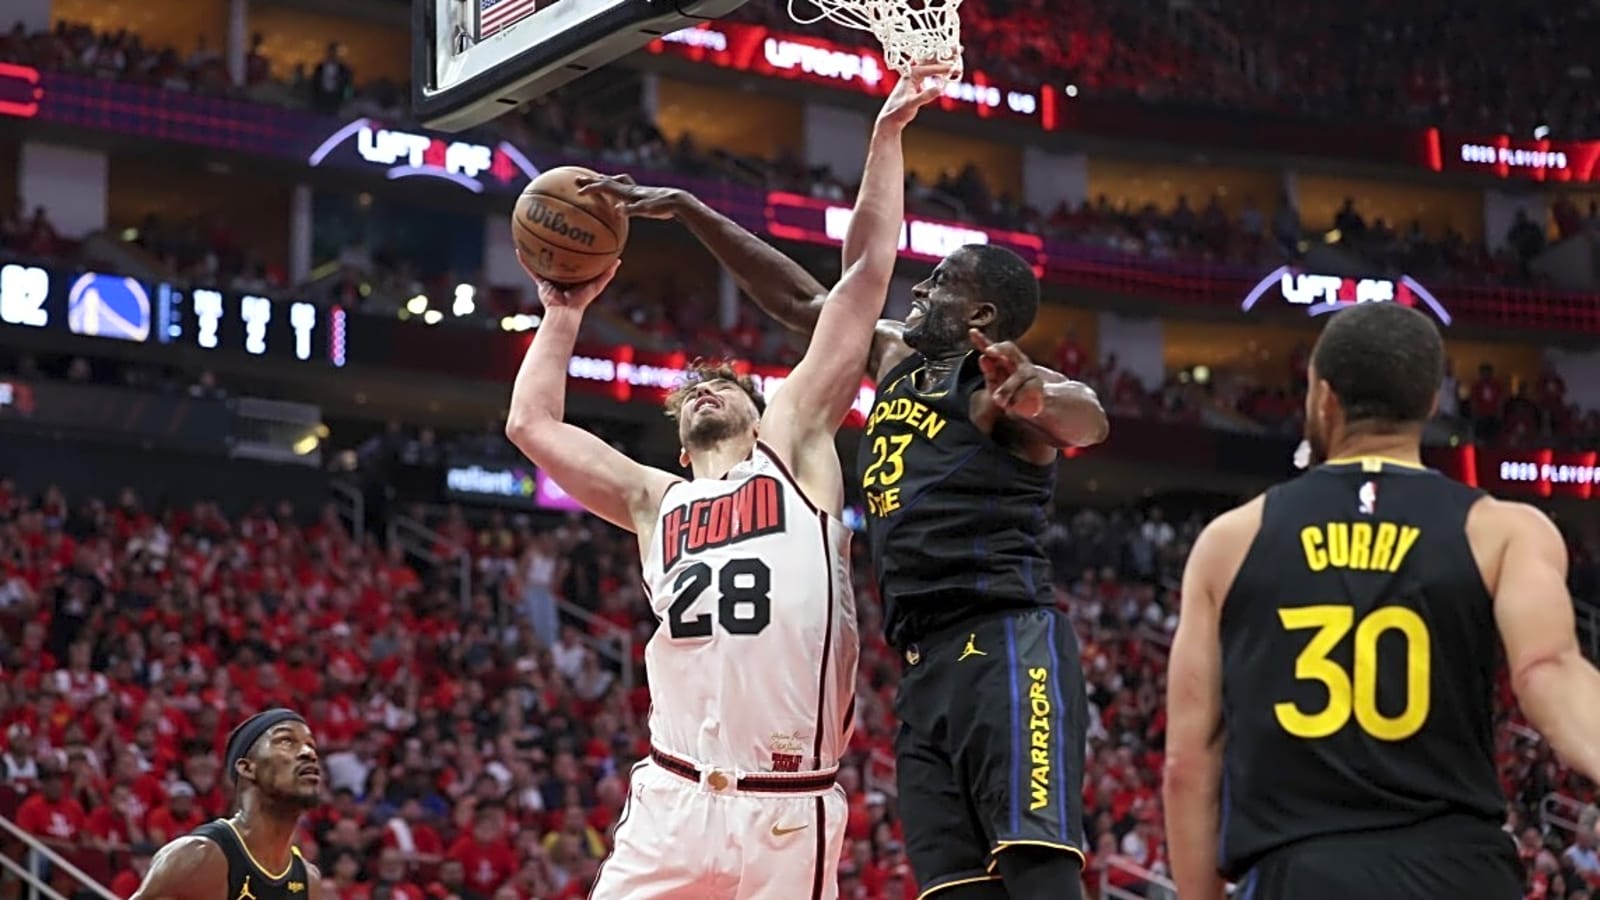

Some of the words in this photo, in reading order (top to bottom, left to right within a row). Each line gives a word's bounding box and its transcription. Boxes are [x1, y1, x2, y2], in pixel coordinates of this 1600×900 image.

[526, 201, 596, 247] Wilson
[863, 433, 913, 488] 23
[1301, 521, 1421, 573] CURRY
[668, 557, 771, 639] 28
[1274, 604, 1431, 741] 30
[1029, 666, 1050, 811] WARRIORS
